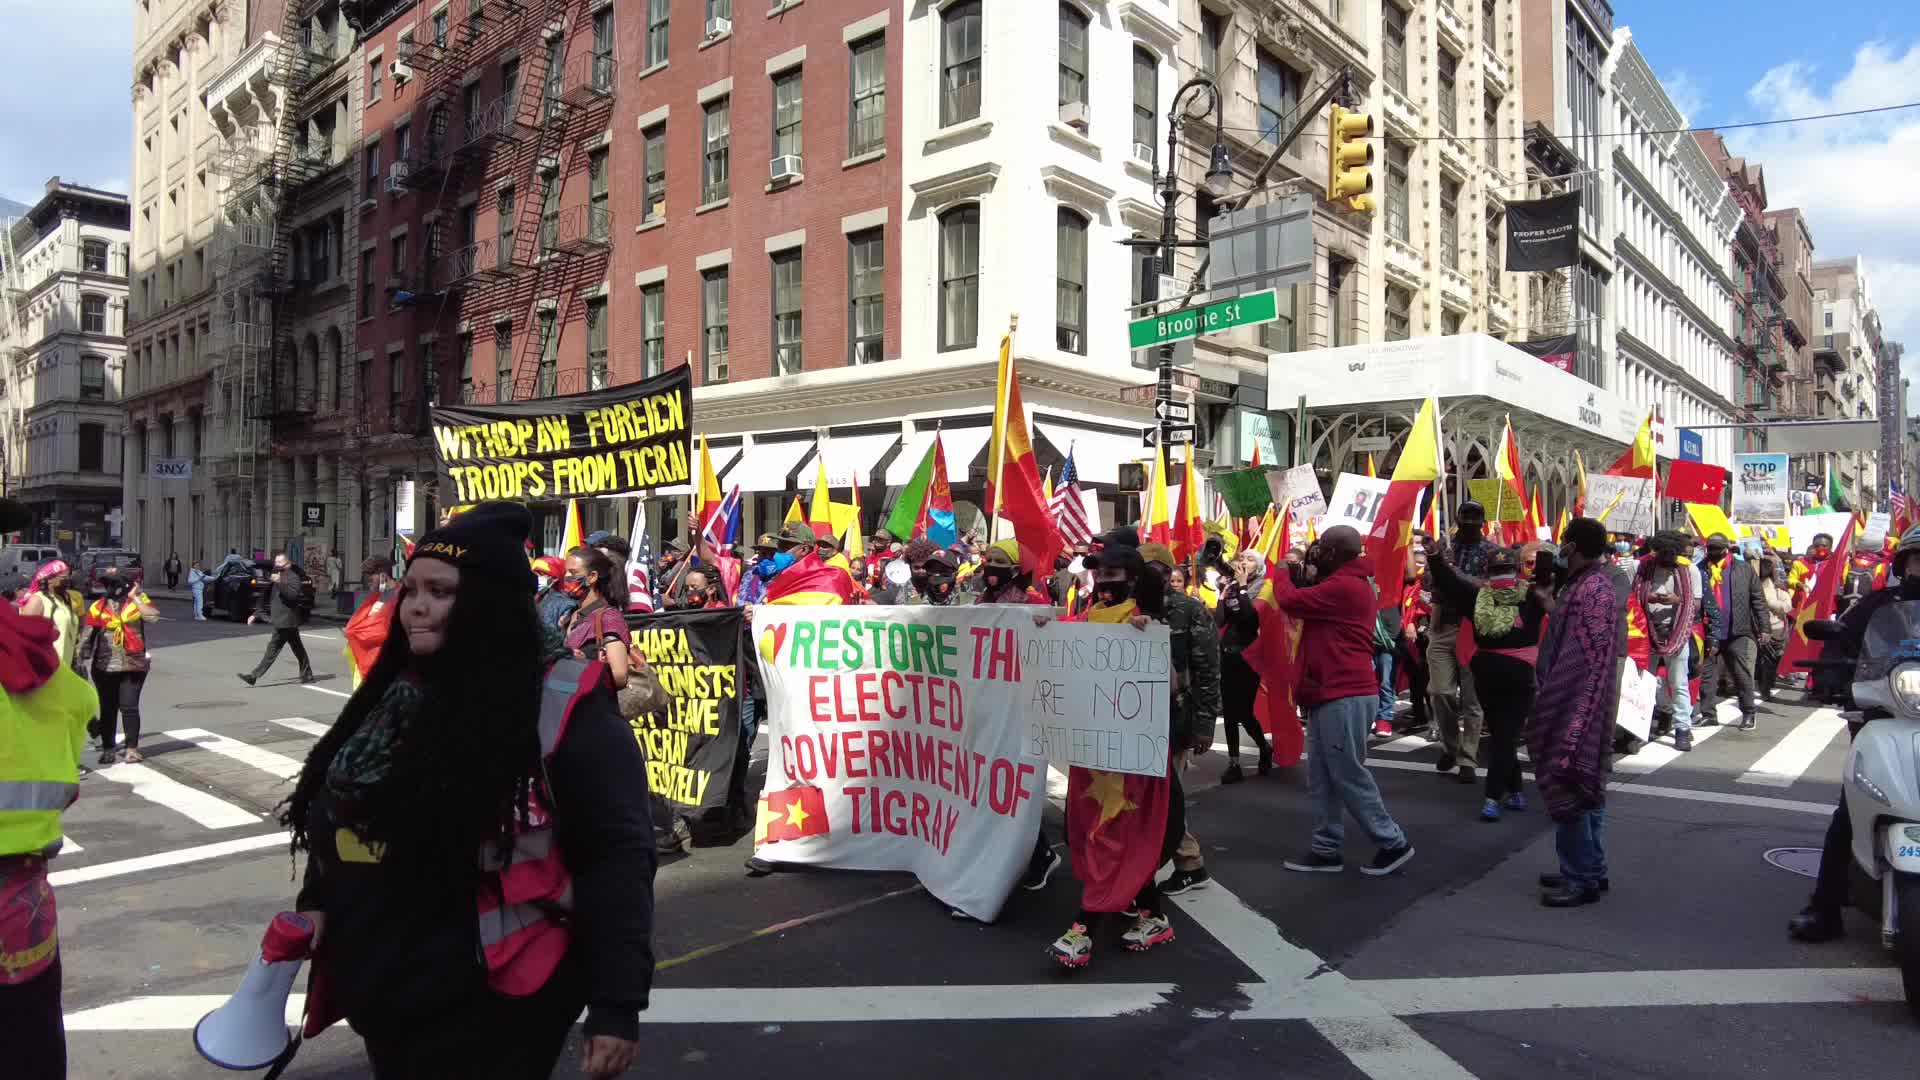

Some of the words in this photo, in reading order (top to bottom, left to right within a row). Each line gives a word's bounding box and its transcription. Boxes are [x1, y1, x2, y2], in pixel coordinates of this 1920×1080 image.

[1157, 311, 1218, 337] Broome
[1225, 303, 1241, 322] St
[449, 460, 547, 501] TROOPS
[552, 452, 618, 497] FROM
[1743, 462, 1777, 477] STOP
[1291, 491, 1321, 508] CRIME
[789, 619, 958, 678] RESTORE
[969, 626, 1022, 683] TH
[1089, 636, 1169, 675] BODIES
[666, 697, 720, 736] LEAVE
[808, 670, 964, 732] ELECTED
[1032, 679, 1065, 716] ARE
[1092, 677, 1168, 722] NOT
[781, 730, 986, 808] GOVERNMENT
[988, 757, 1036, 818] OF
[843, 786, 960, 857] TIGRAY
